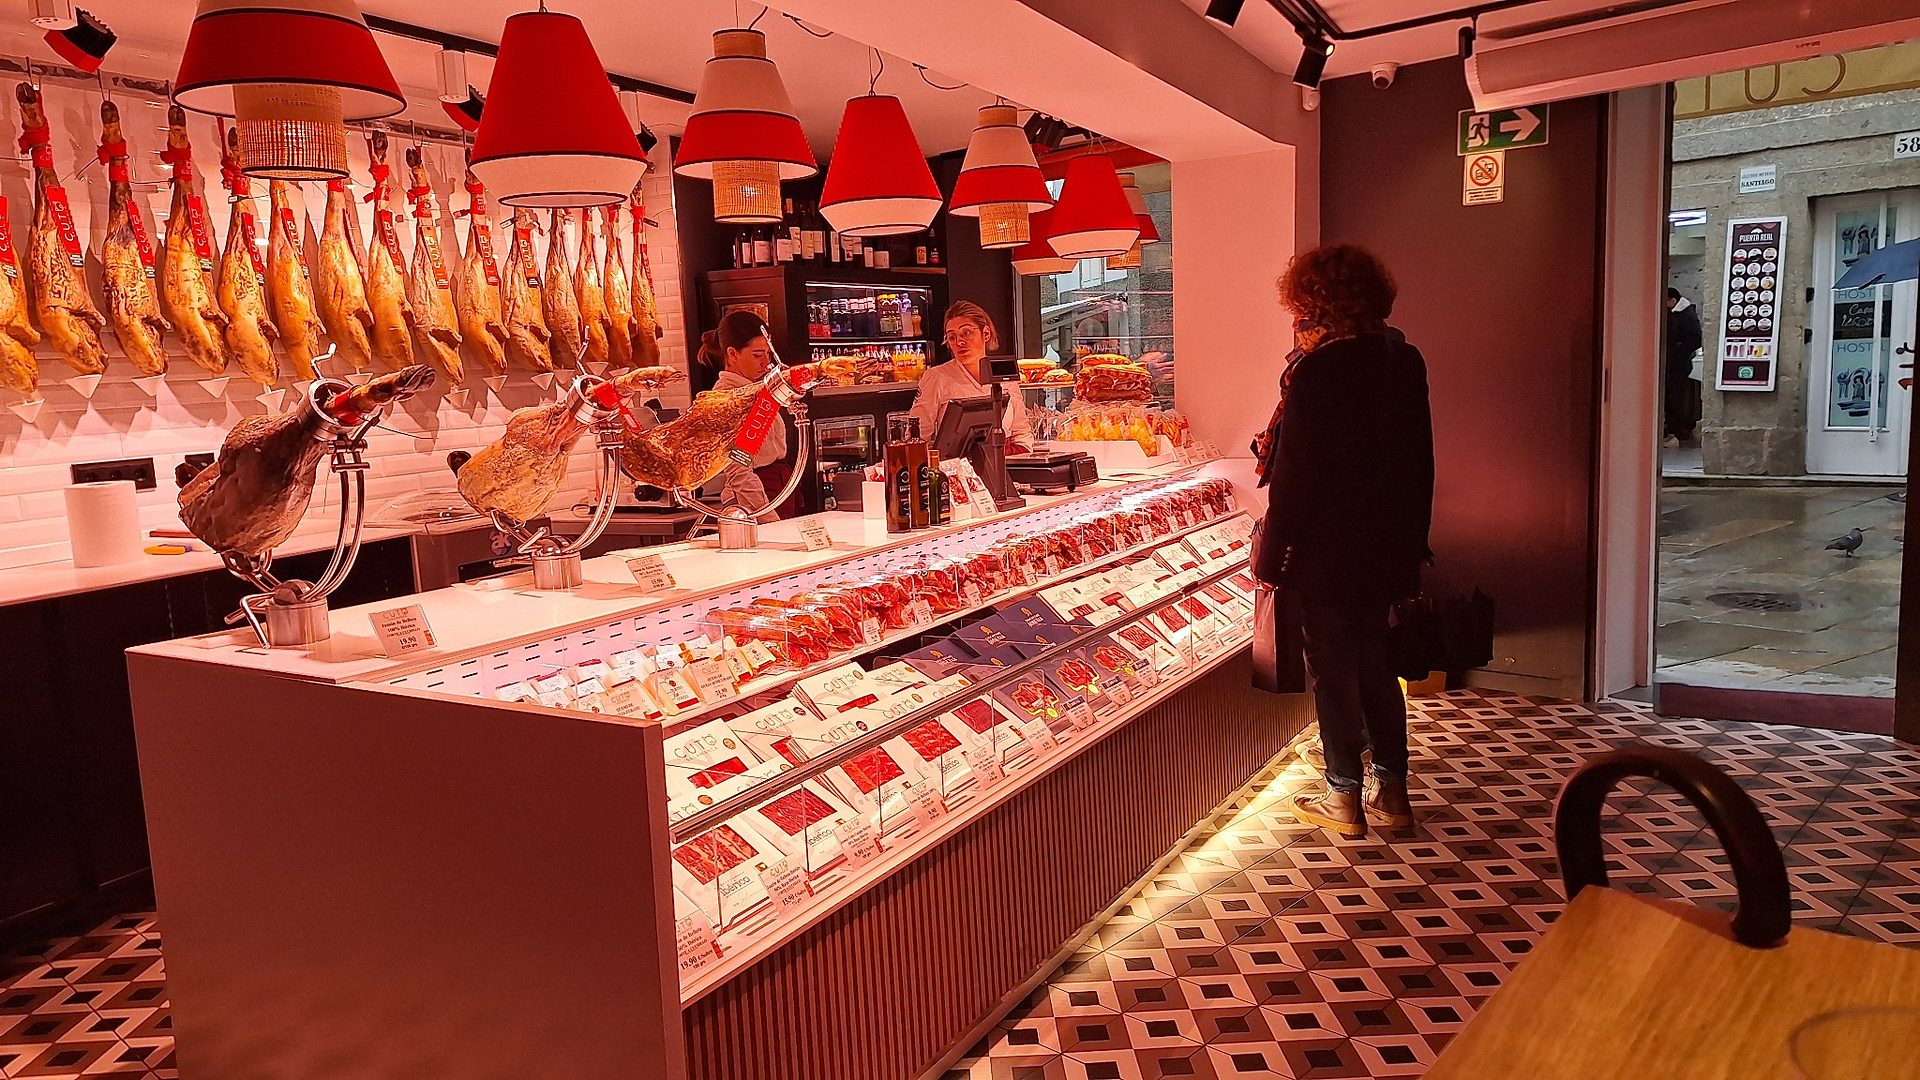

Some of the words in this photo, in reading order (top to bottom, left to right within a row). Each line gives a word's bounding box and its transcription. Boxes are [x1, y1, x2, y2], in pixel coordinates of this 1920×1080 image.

[1741, 179, 1775, 188] SANTIAGO
[53, 201, 75, 242] CUTO
[133, 214, 149, 253] CUTO
[1739, 233, 1760, 243] PUERTA
[1760, 233, 1774, 242] REAL
[426, 236, 442, 269] CUTO
[522, 240, 533, 269] CUTO
[1838, 288, 1888, 299] HOSTL
[1836, 342, 1888, 353] HOSTL
[746, 398, 772, 440] CUTO
[383, 607, 409, 619] CUTO
[824, 673, 857, 693] CUTO
[883, 699, 916, 719] CUTO
[755, 708, 794, 731] CUTO
[820, 720, 858, 743] CUTO
[674, 733, 717, 759] CUTO
[842, 817, 860, 833] CUTO
[770, 859, 789, 877] CUTO
[680, 955, 698, 970] 19.90
